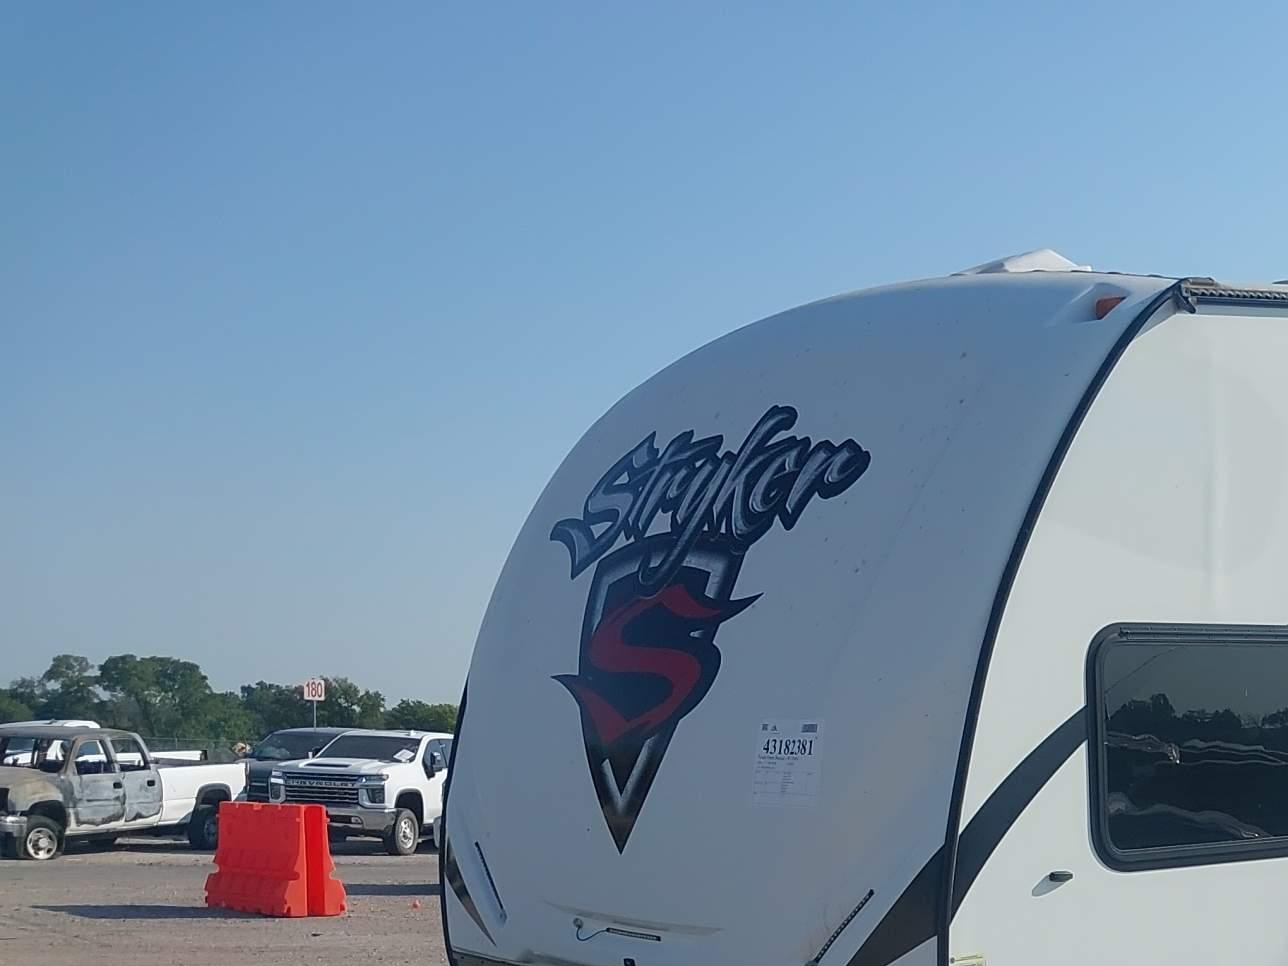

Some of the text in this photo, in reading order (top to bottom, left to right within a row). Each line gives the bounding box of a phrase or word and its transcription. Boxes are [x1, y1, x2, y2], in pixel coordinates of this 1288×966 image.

[550, 404, 872, 589] Stryker
[306, 681, 323, 698] 180
[762, 738, 814, 756] 43182381
